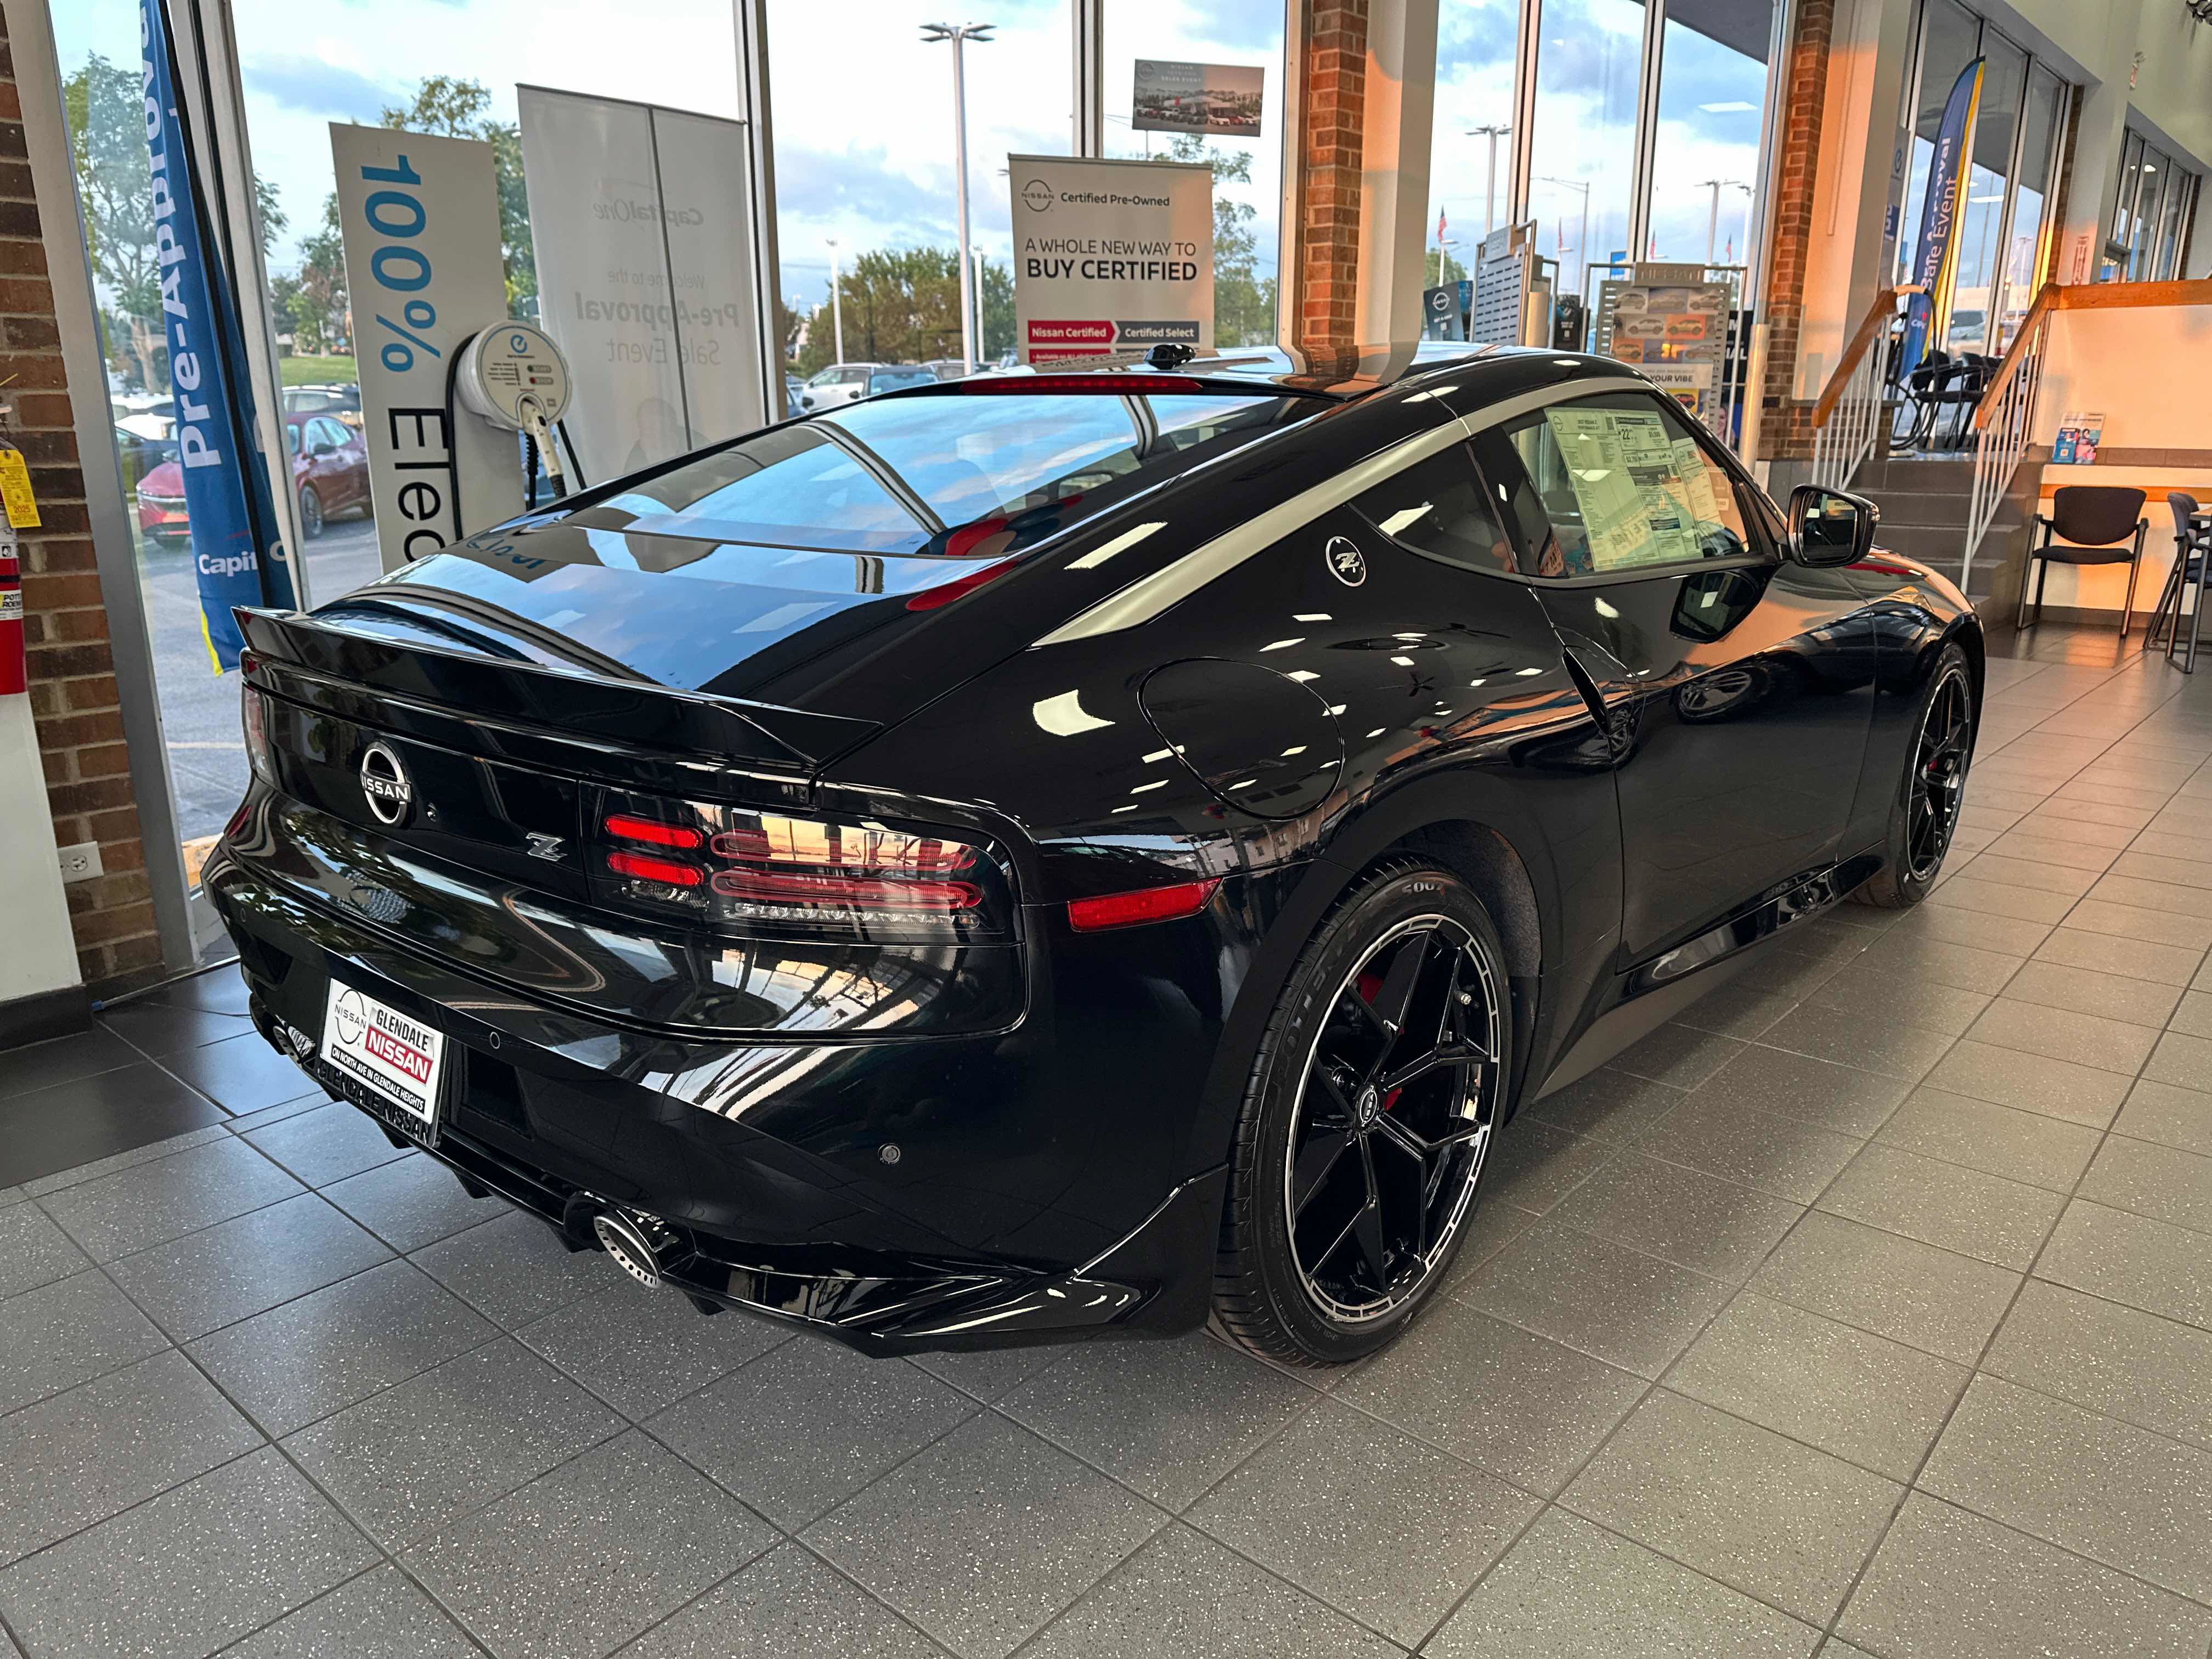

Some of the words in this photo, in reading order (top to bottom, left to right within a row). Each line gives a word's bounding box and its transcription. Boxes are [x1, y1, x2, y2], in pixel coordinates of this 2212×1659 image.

[1061, 192, 1108, 204] Certified
[1110, 195, 1170, 206] Pre-Owned
[1025, 238, 1036, 253] A
[1040, 239, 1097, 255] WHOLE
[1102, 240, 1136, 256] NEW
[1138, 241, 1171, 256] WAY
[1175, 242, 1196, 256] TO
[360, 154, 441, 373] 100%
[1027, 258, 1075, 279] BUY
[1081, 259, 1198, 281] CERTIFIED
[1032, 328, 1064, 338] Nissan
[1065, 328, 1107, 338] Certified
[1124, 328, 1164, 338] Certified
[1165, 328, 1195, 338] Select
[1621, 428, 1630, 439] 22
[13, 505, 31, 514] 2025
[362, 774, 408, 800] NISSAN
[335, 1003, 367, 1030] NISSAN
[376, 1008, 430, 1051] GLENDALE
[368, 1030, 429, 1081] NISSAN
[332, 1047, 341, 1059] ON
[340, 1049, 357, 1069] NORTH
[357, 1062, 367, 1075] AVE
[366, 1066, 374, 1079] IN
[373, 1071, 401, 1097] GLENDALE
[400, 1089, 424, 1110] HEIGHTS
